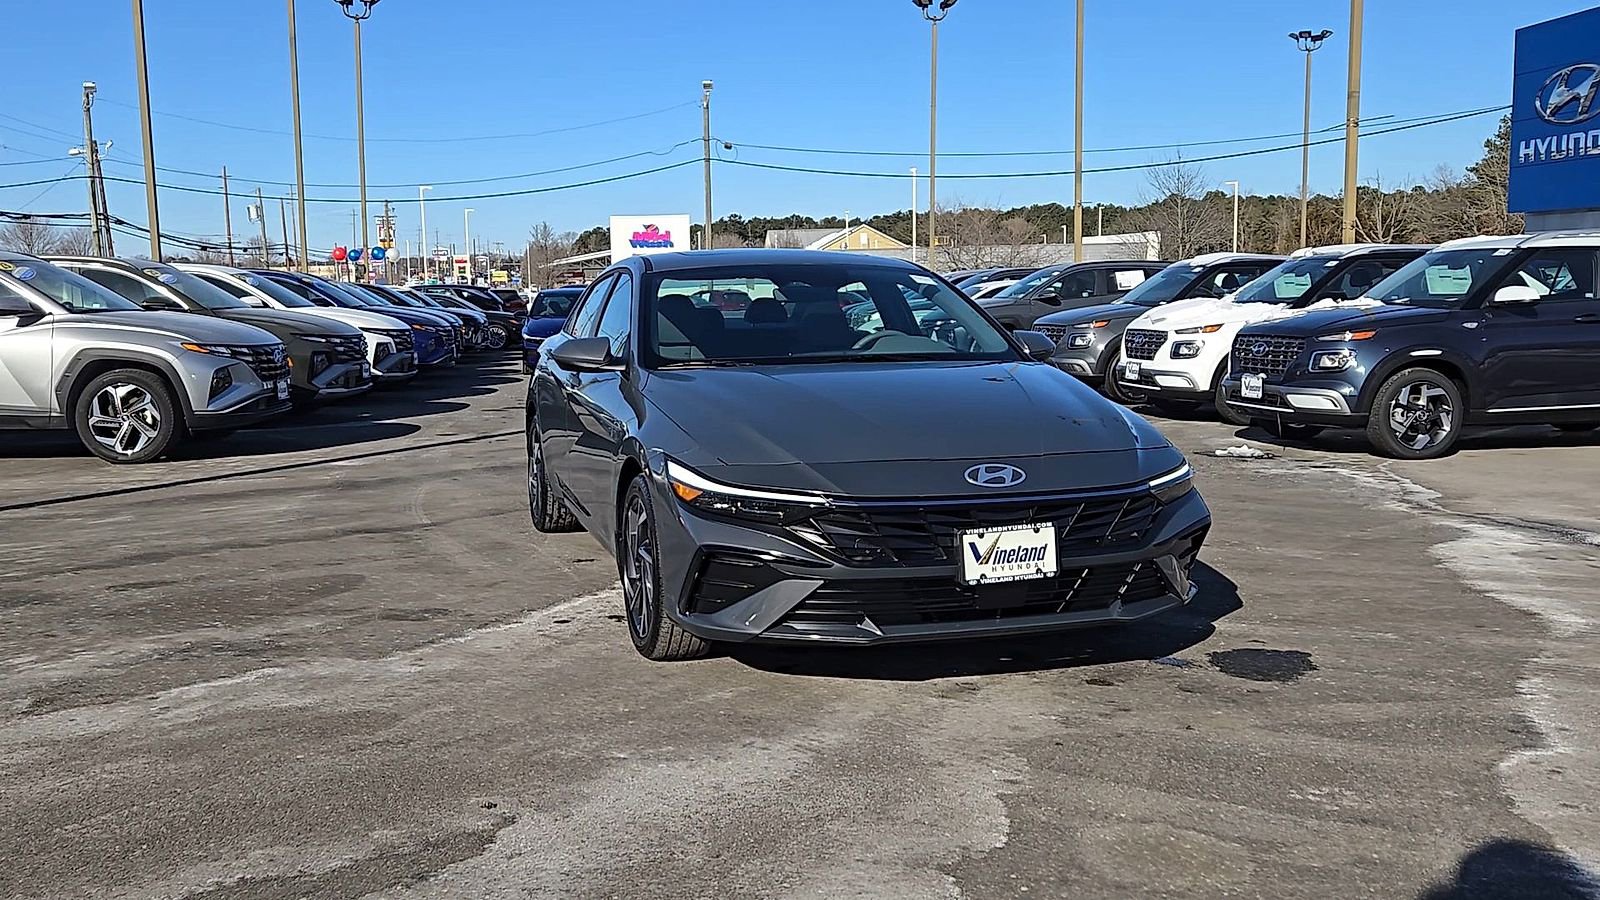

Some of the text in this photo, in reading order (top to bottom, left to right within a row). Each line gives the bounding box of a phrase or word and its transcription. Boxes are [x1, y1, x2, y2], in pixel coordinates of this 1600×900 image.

[965, 521, 1053, 535] VINELANDHYUNDAI.COM
[968, 532, 1048, 566] Vineland
[991, 562, 1046, 573] HYUNDAI
[980, 572, 1044, 585] VINELAND HYUNDAI
